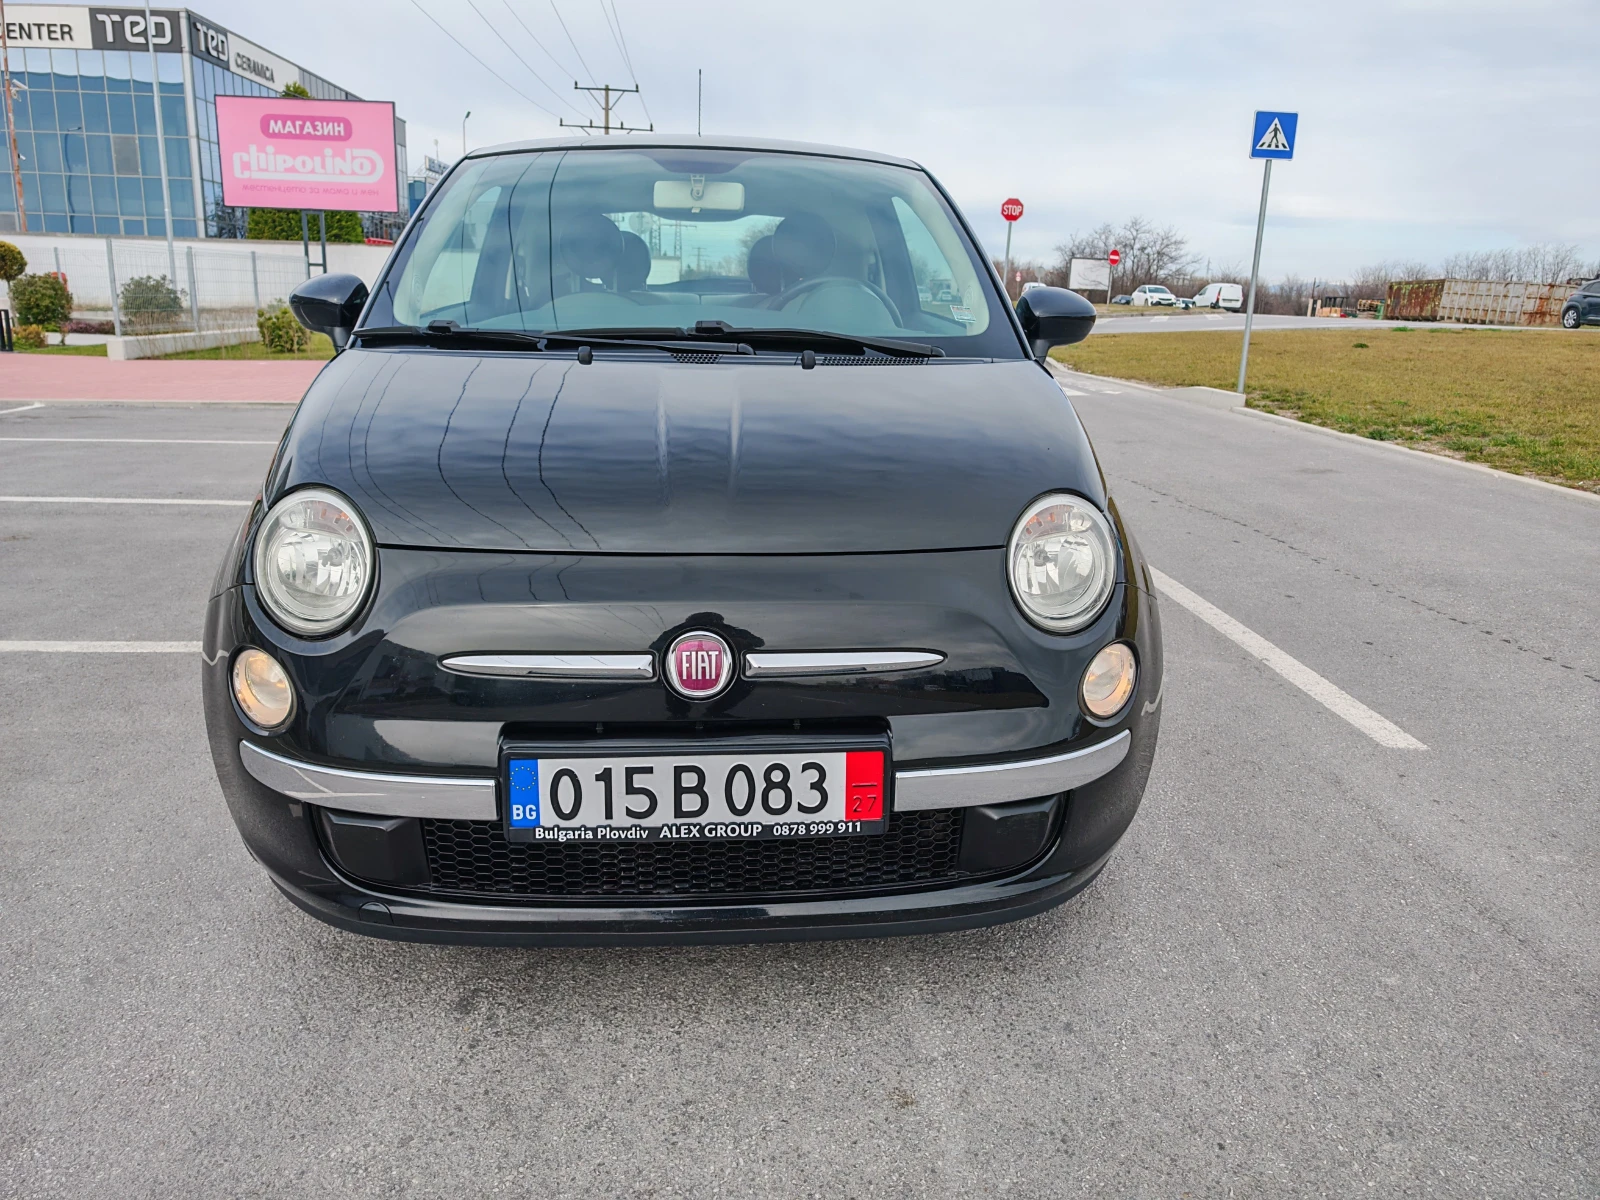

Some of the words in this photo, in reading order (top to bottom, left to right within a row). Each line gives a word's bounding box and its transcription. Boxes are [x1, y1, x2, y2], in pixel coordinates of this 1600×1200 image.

[0, 22, 74, 41] ENTER
[235, 52, 275, 83] CERAMICA
[269, 119, 345, 136] МАГАЗИН
[309, 186, 320, 194] за
[1003, 204, 1022, 216] STOP
[682, 651, 719, 680] FIAT
[512, 804, 537, 821] BG
[852, 795, 877, 813] 27
[535, 827, 593, 842] Bulgaria
[597, 826, 649, 839] Plovdiv
[659, 825, 700, 838] ALEX
[704, 824, 763, 837] GROUP
[772, 823, 806, 835] 0878
[809, 822, 834, 834] 999
[837, 821, 862, 833] 911
